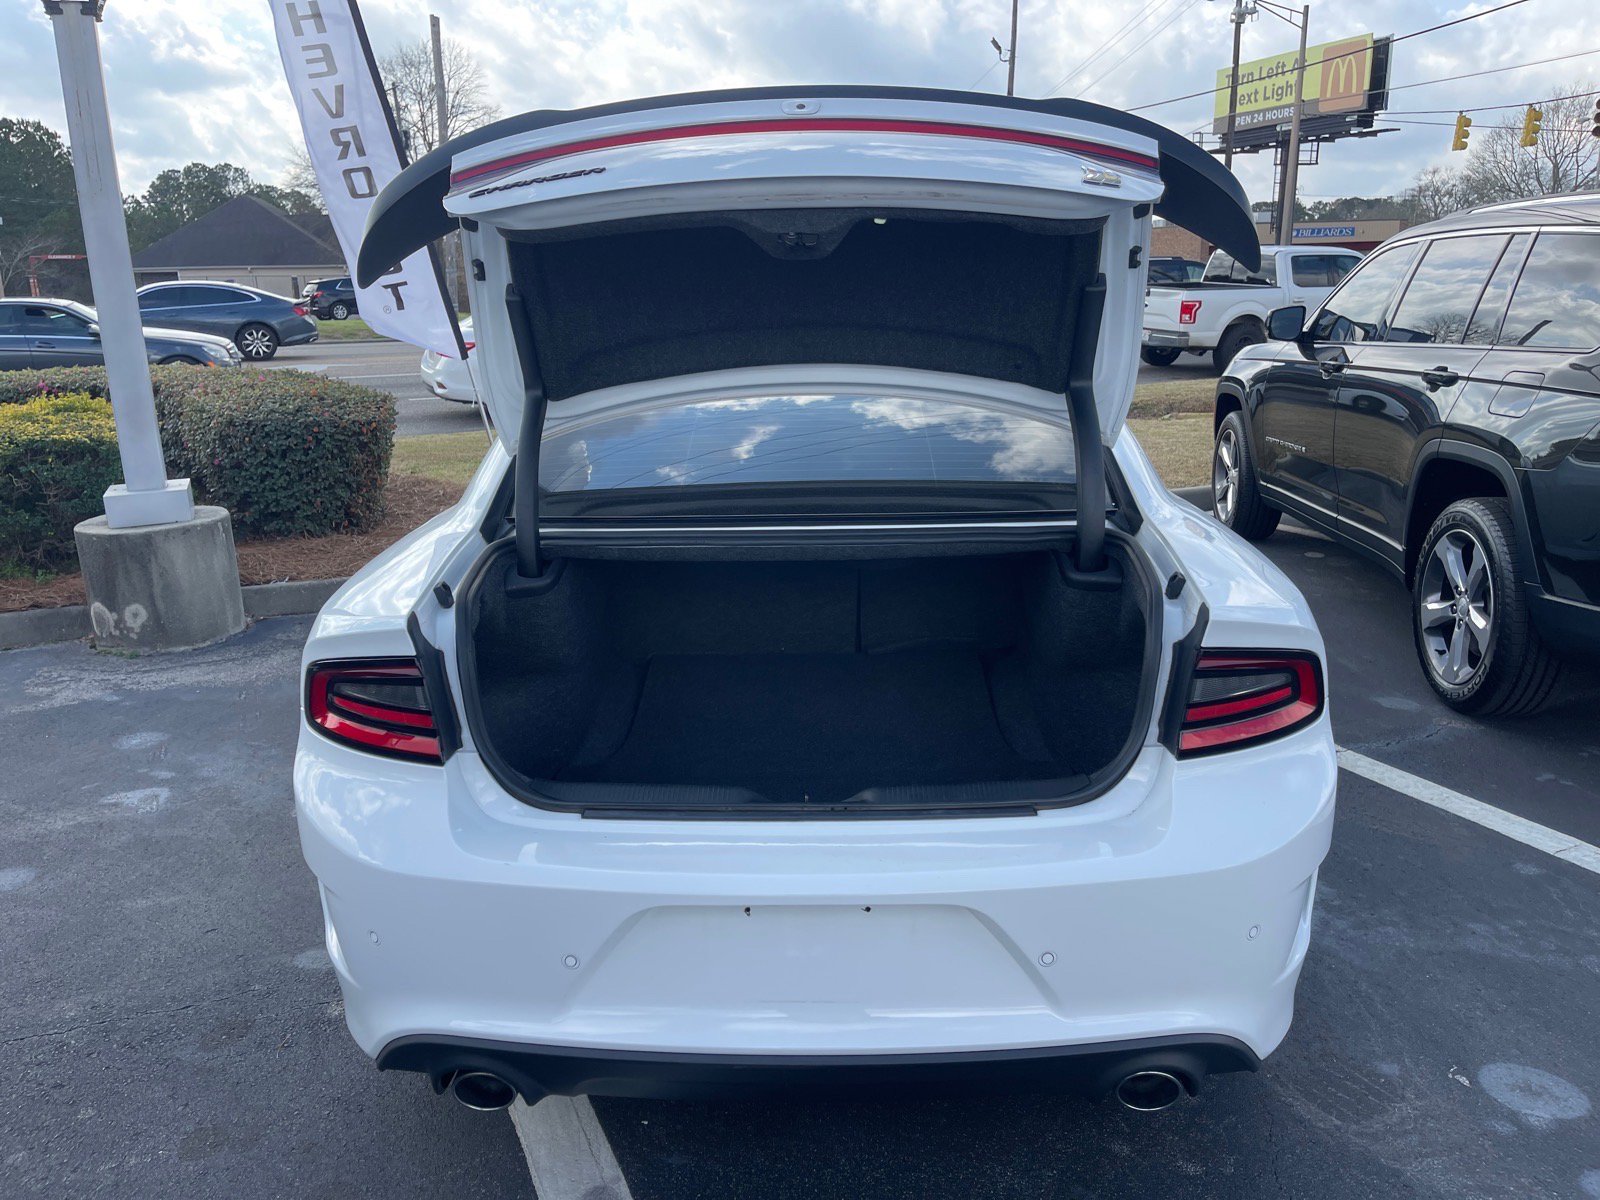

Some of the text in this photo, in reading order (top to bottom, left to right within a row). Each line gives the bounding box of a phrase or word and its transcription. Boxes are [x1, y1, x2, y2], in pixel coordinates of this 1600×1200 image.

[1225, 70, 1254, 87] Trn
[1258, 60, 1287, 81] Left
[1237, 79, 1298, 106] ext Ligh
[1234, 106, 1295, 127] PEN 24 HOURS
[1298, 227, 1353, 238] BILLIARDS
